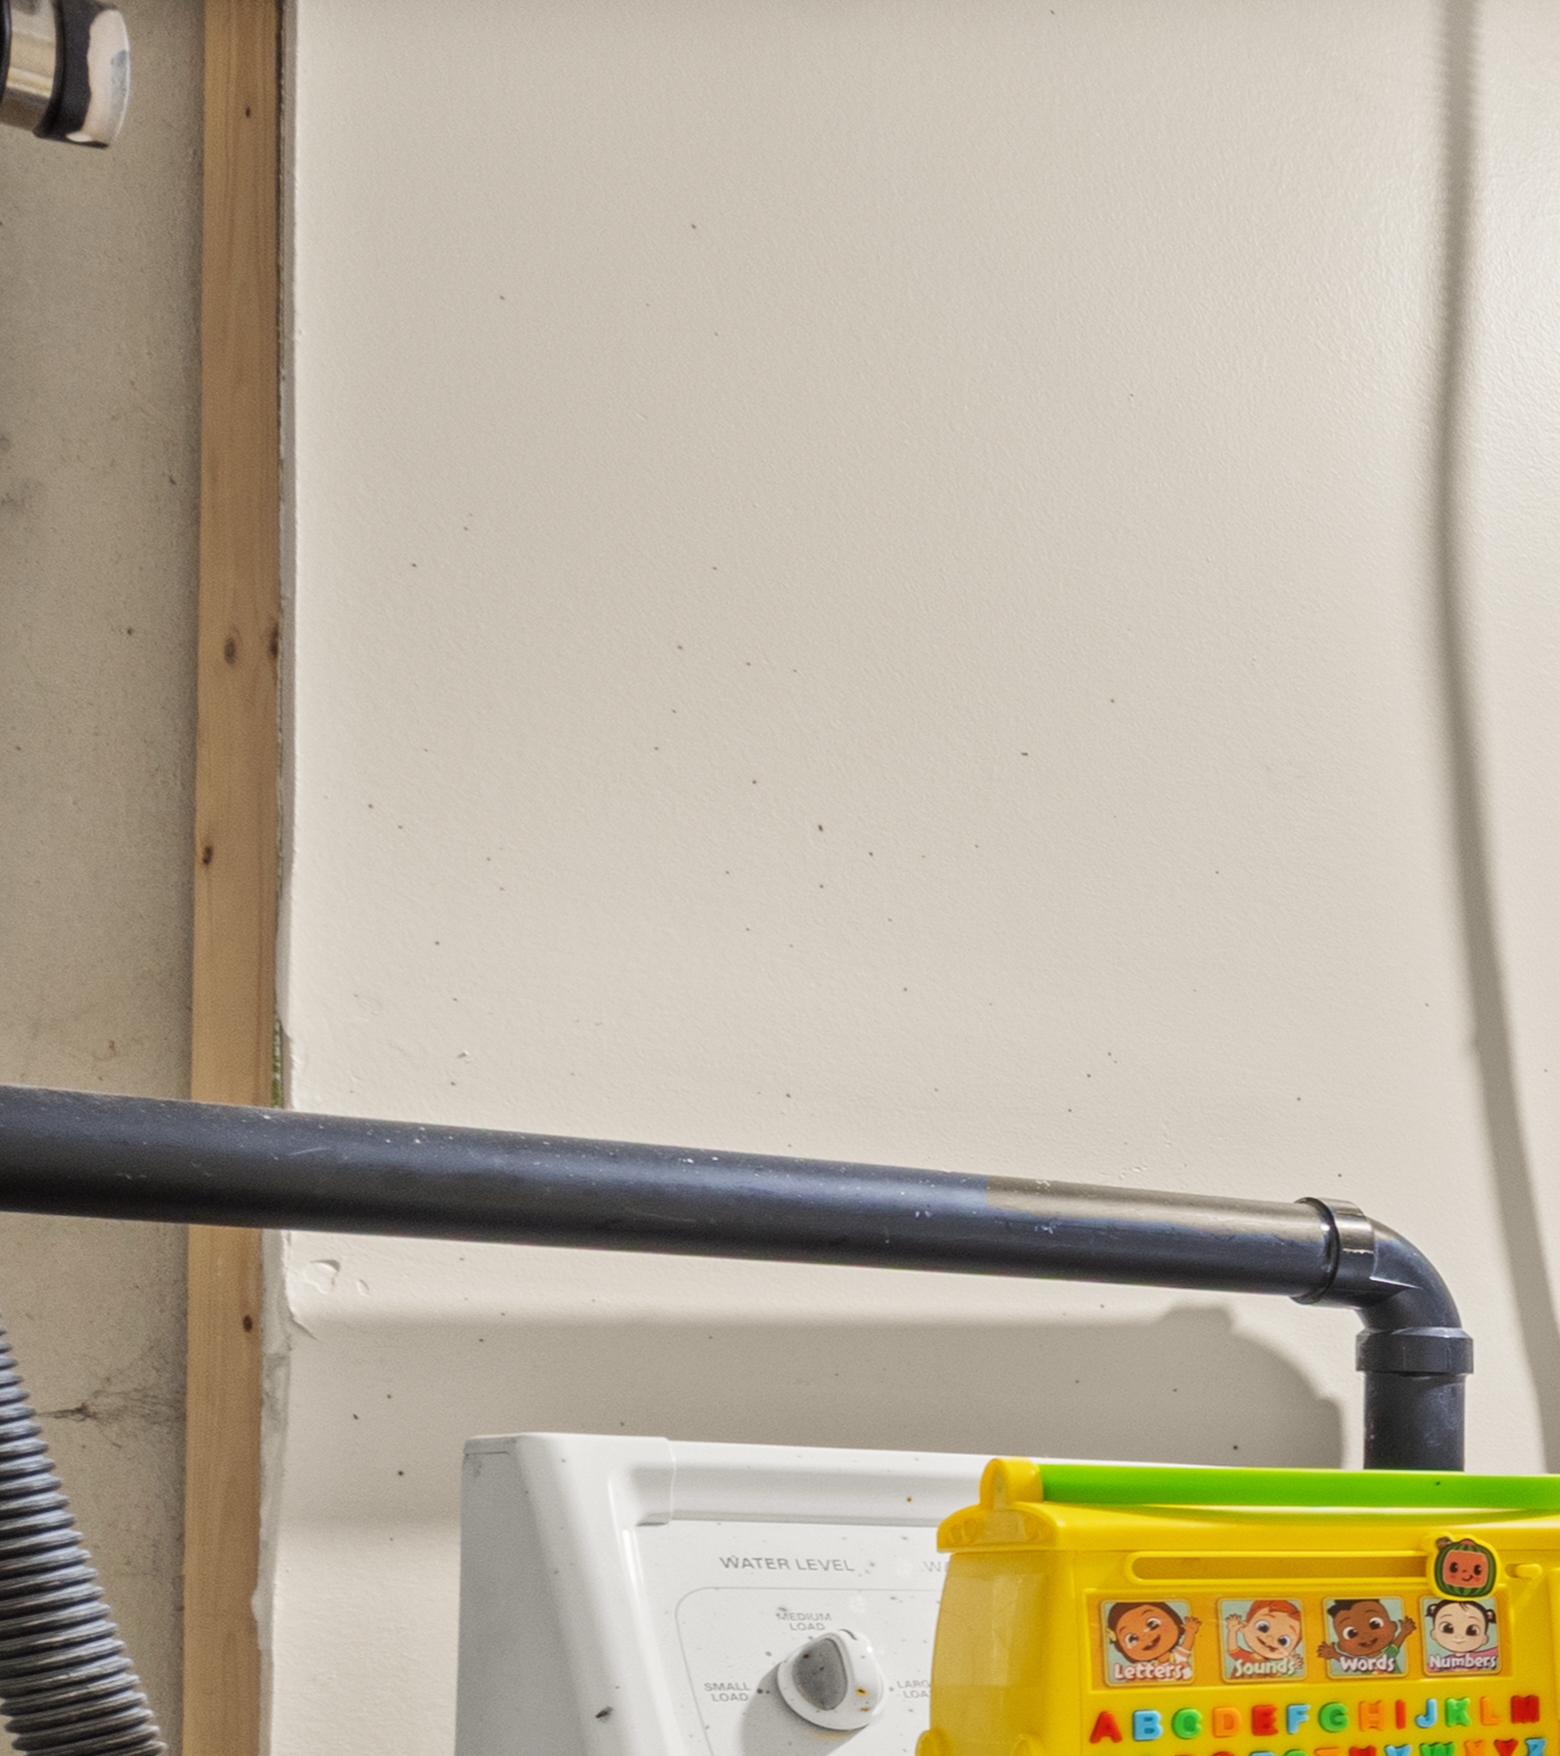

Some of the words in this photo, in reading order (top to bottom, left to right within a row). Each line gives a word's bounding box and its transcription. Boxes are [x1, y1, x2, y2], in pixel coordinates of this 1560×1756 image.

[719, 1556, 790, 1571] WATER
[795, 1558, 856, 1573] LEVEL
[775, 1612, 832, 1622] MEDIUM
[789, 1622, 826, 1632] LOAD
[1340, 1655, 1396, 1672] Words
[1429, 1654, 1498, 1670] Numbers
[1113, 1663, 1183, 1681] Letters
[1234, 1659, 1296, 1677] Sounds
[703, 1682, 752, 1692] SMALL
[897, 1680, 931, 1690] LARG
[711, 1692, 750, 1703] LOAD
[902, 1690, 931, 1699] LOA
